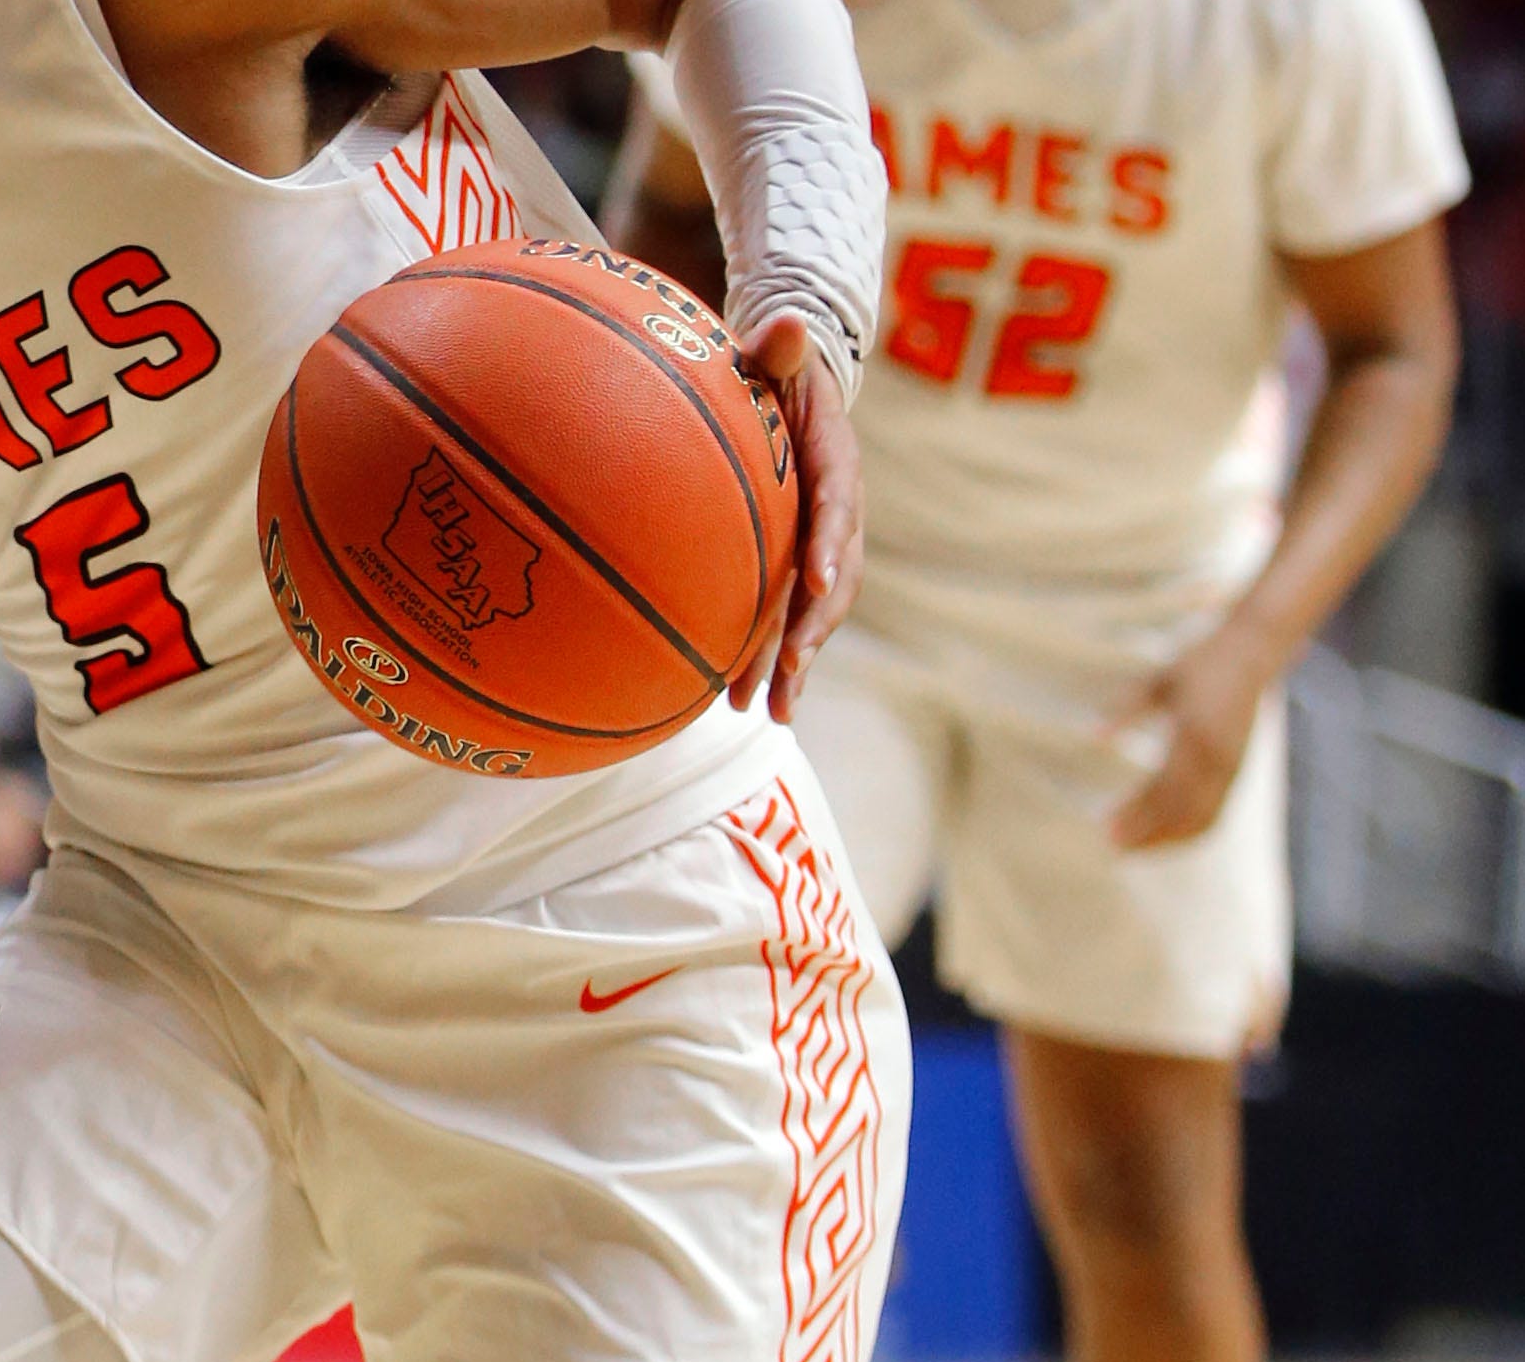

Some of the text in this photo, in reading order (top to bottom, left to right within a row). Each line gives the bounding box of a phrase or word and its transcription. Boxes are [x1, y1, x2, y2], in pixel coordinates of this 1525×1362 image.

[14, 471, 215, 716] 5
[362, 546, 473, 650] IOWA HIGH SCHOOL
[417, 470, 491, 618] IHSAA
[265, 516, 535, 775] SPALDING
[399, 599, 481, 670] ASSOCIATION
